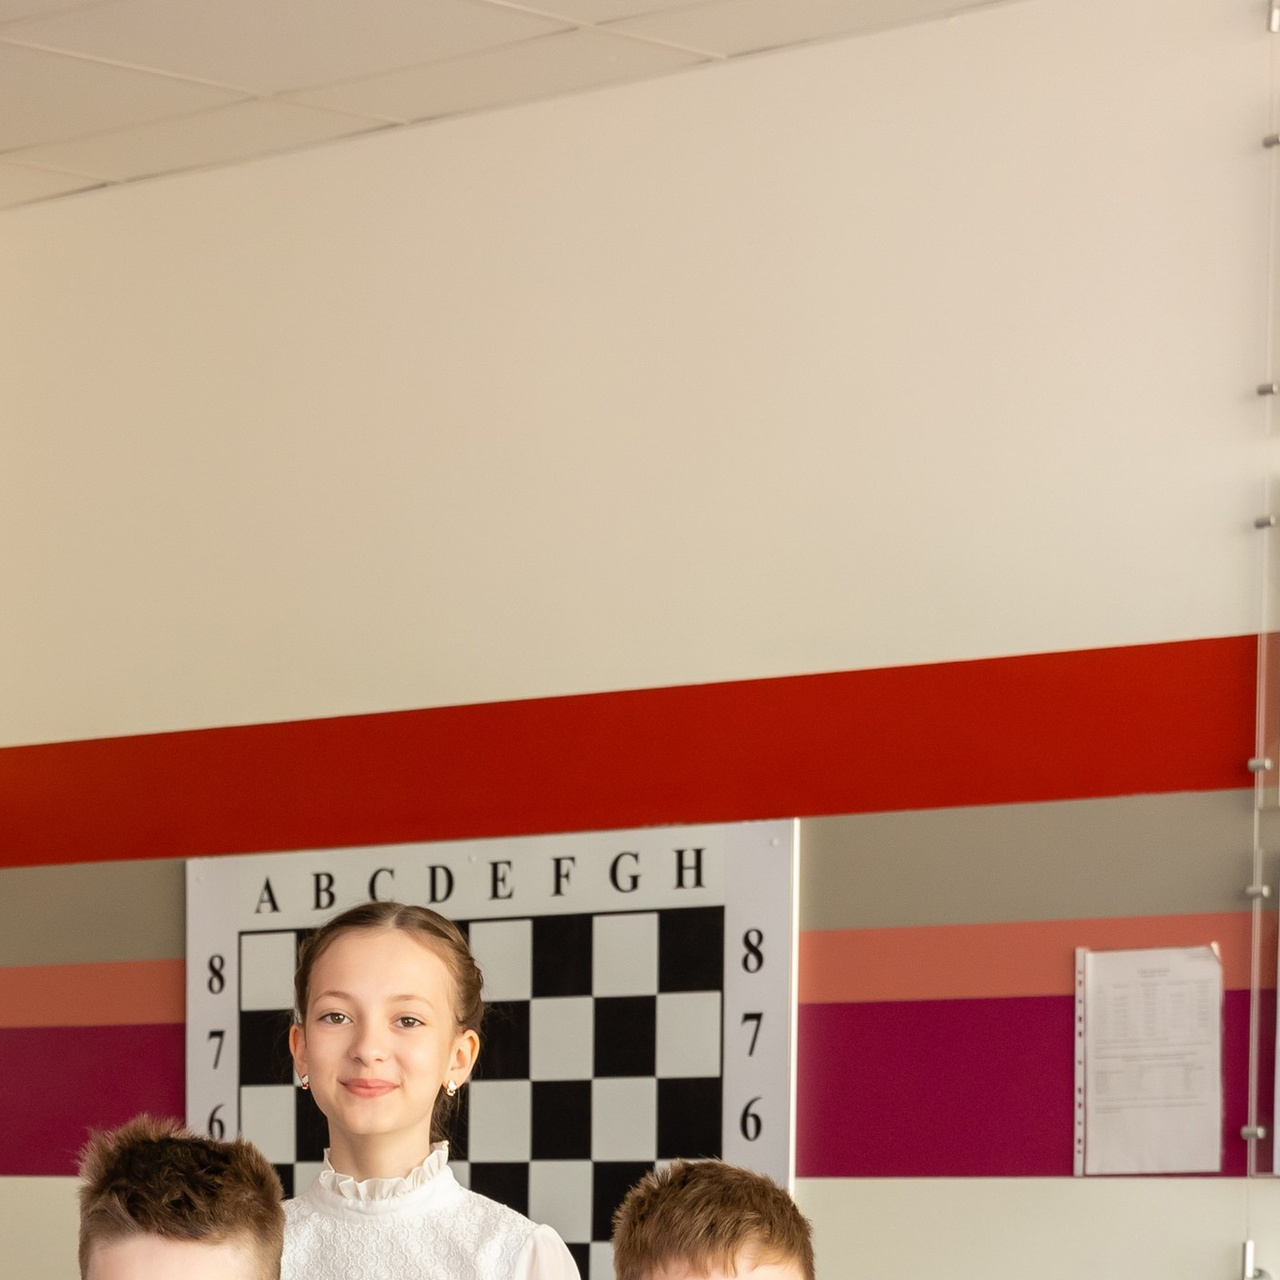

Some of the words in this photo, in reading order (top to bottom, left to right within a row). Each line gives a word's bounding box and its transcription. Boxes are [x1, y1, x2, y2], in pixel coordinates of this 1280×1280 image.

[255, 877, 281, 914] A
[313, 873, 336, 910] B
[368, 868, 396, 902] C
[427, 865, 455, 902] D
[489, 861, 514, 900] E
[551, 857, 576, 897] F
[609, 852, 642, 894] G
[674, 848, 706, 889] H
[741, 928, 764, 974] 8
[207, 954, 226, 995] 8
[207, 1029, 226, 1070] 7
[740, 1011, 764, 1057] 7
[207, 1103, 226, 1141] 6
[739, 1097, 763, 1142] 6
